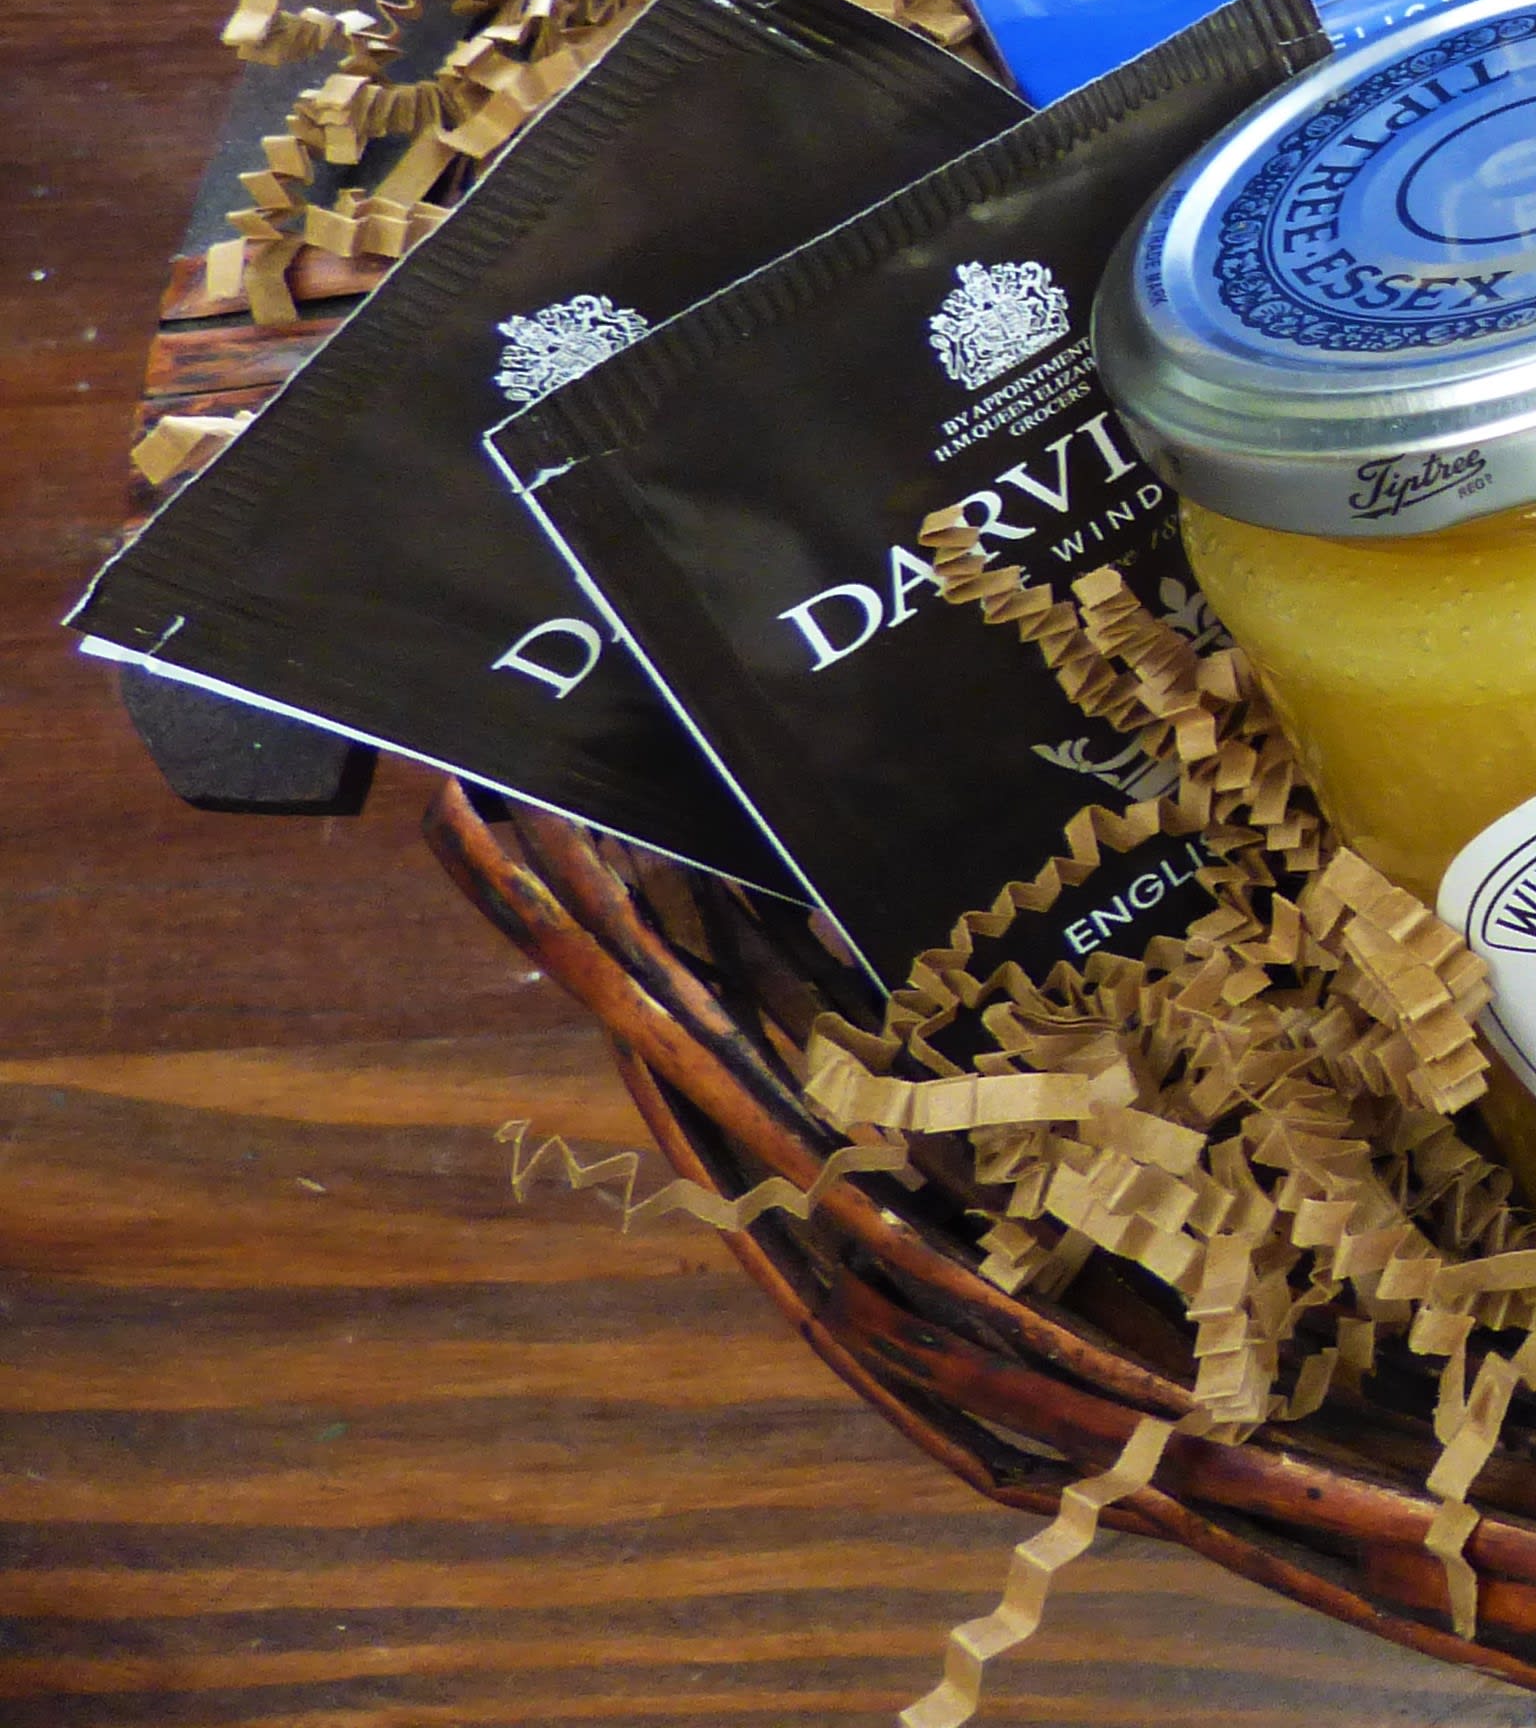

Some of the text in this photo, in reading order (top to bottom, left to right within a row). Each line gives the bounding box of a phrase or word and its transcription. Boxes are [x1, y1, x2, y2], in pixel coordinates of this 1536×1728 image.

[1282, 58, 1513, 256] TIPTREE
[1291, 246, 1513, 312] ESSEX
[942, 336, 1092, 437] BY APPOINTMENT
[1009, 380, 1092, 438] GROCERS
[1348, 448, 1487, 520] Tiptree
[1050, 483, 1164, 563] WIND
